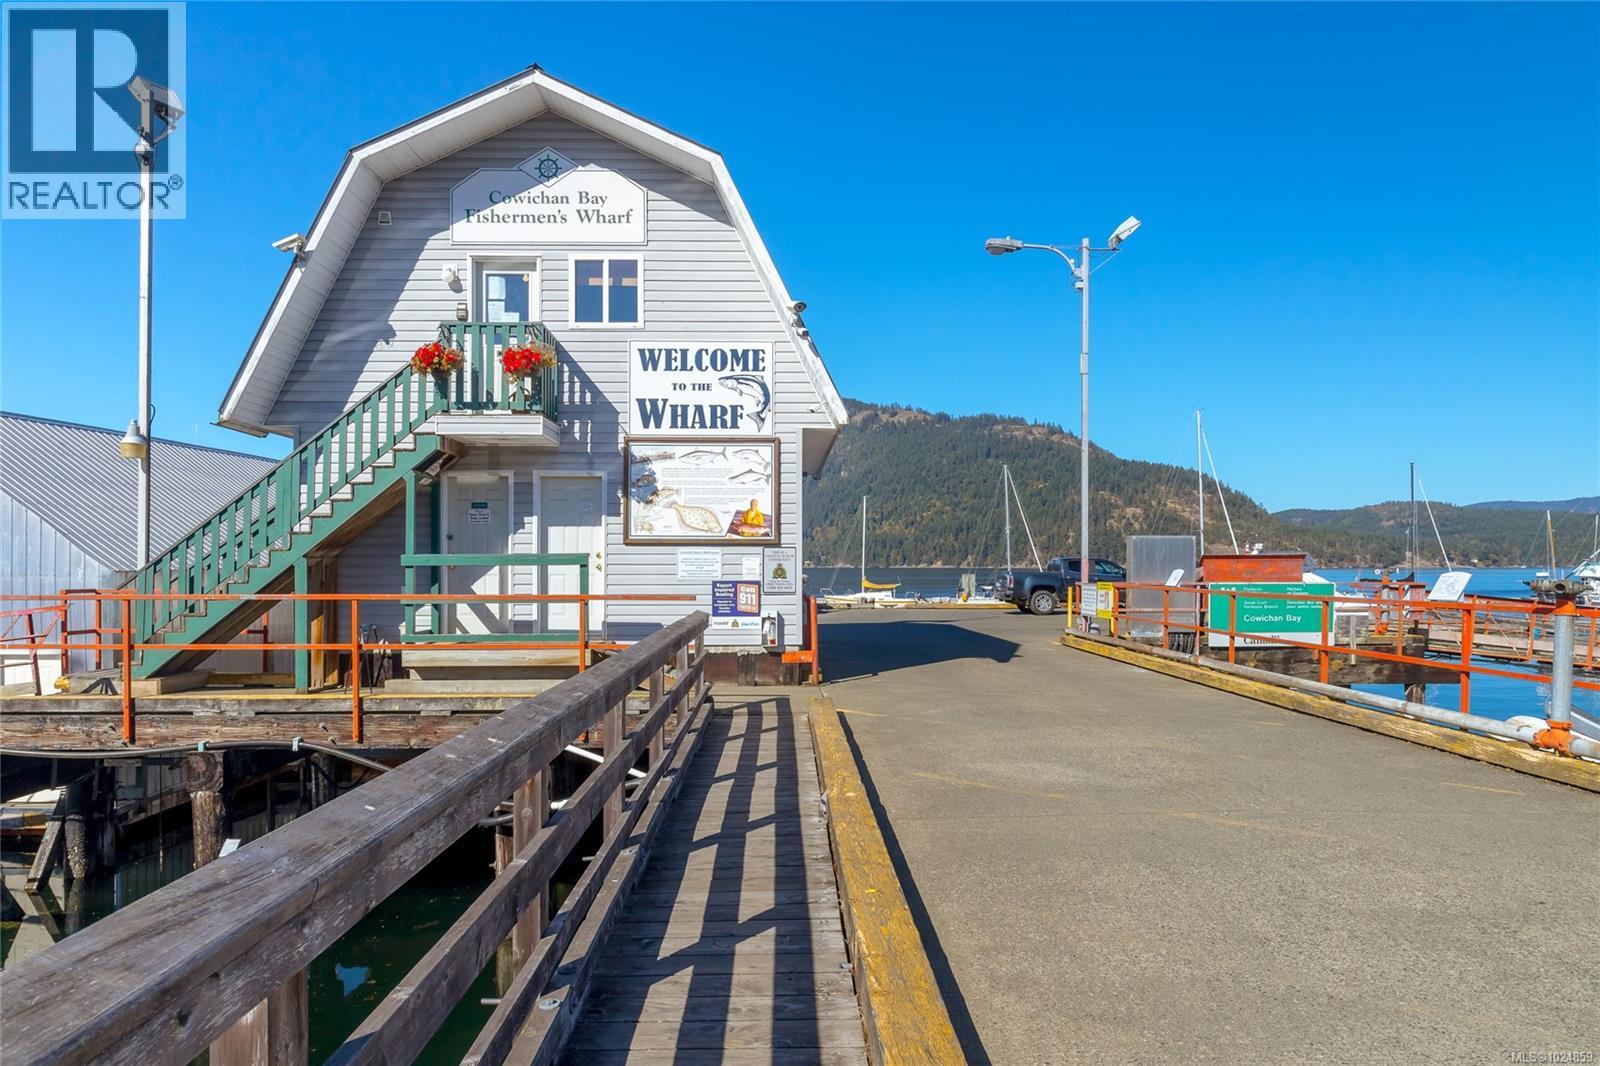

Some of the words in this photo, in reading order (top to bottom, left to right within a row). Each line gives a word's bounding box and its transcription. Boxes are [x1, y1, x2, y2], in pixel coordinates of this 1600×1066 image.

[489, 190, 570, 205] Cowichan
[577, 190, 608, 208] Bay
[464, 208, 568, 225] Fishermen's
[576, 208, 633, 225] Wharf
[637, 348, 766, 372] WELCOME
[671, 382, 687, 392] TO
[691, 382, 713, 391] THE
[635, 398, 744, 430] WHARF
[739, 593, 756, 605] 911
[1243, 614, 1283, 622] Cowichan
[1286, 614, 1301, 623] Bay
